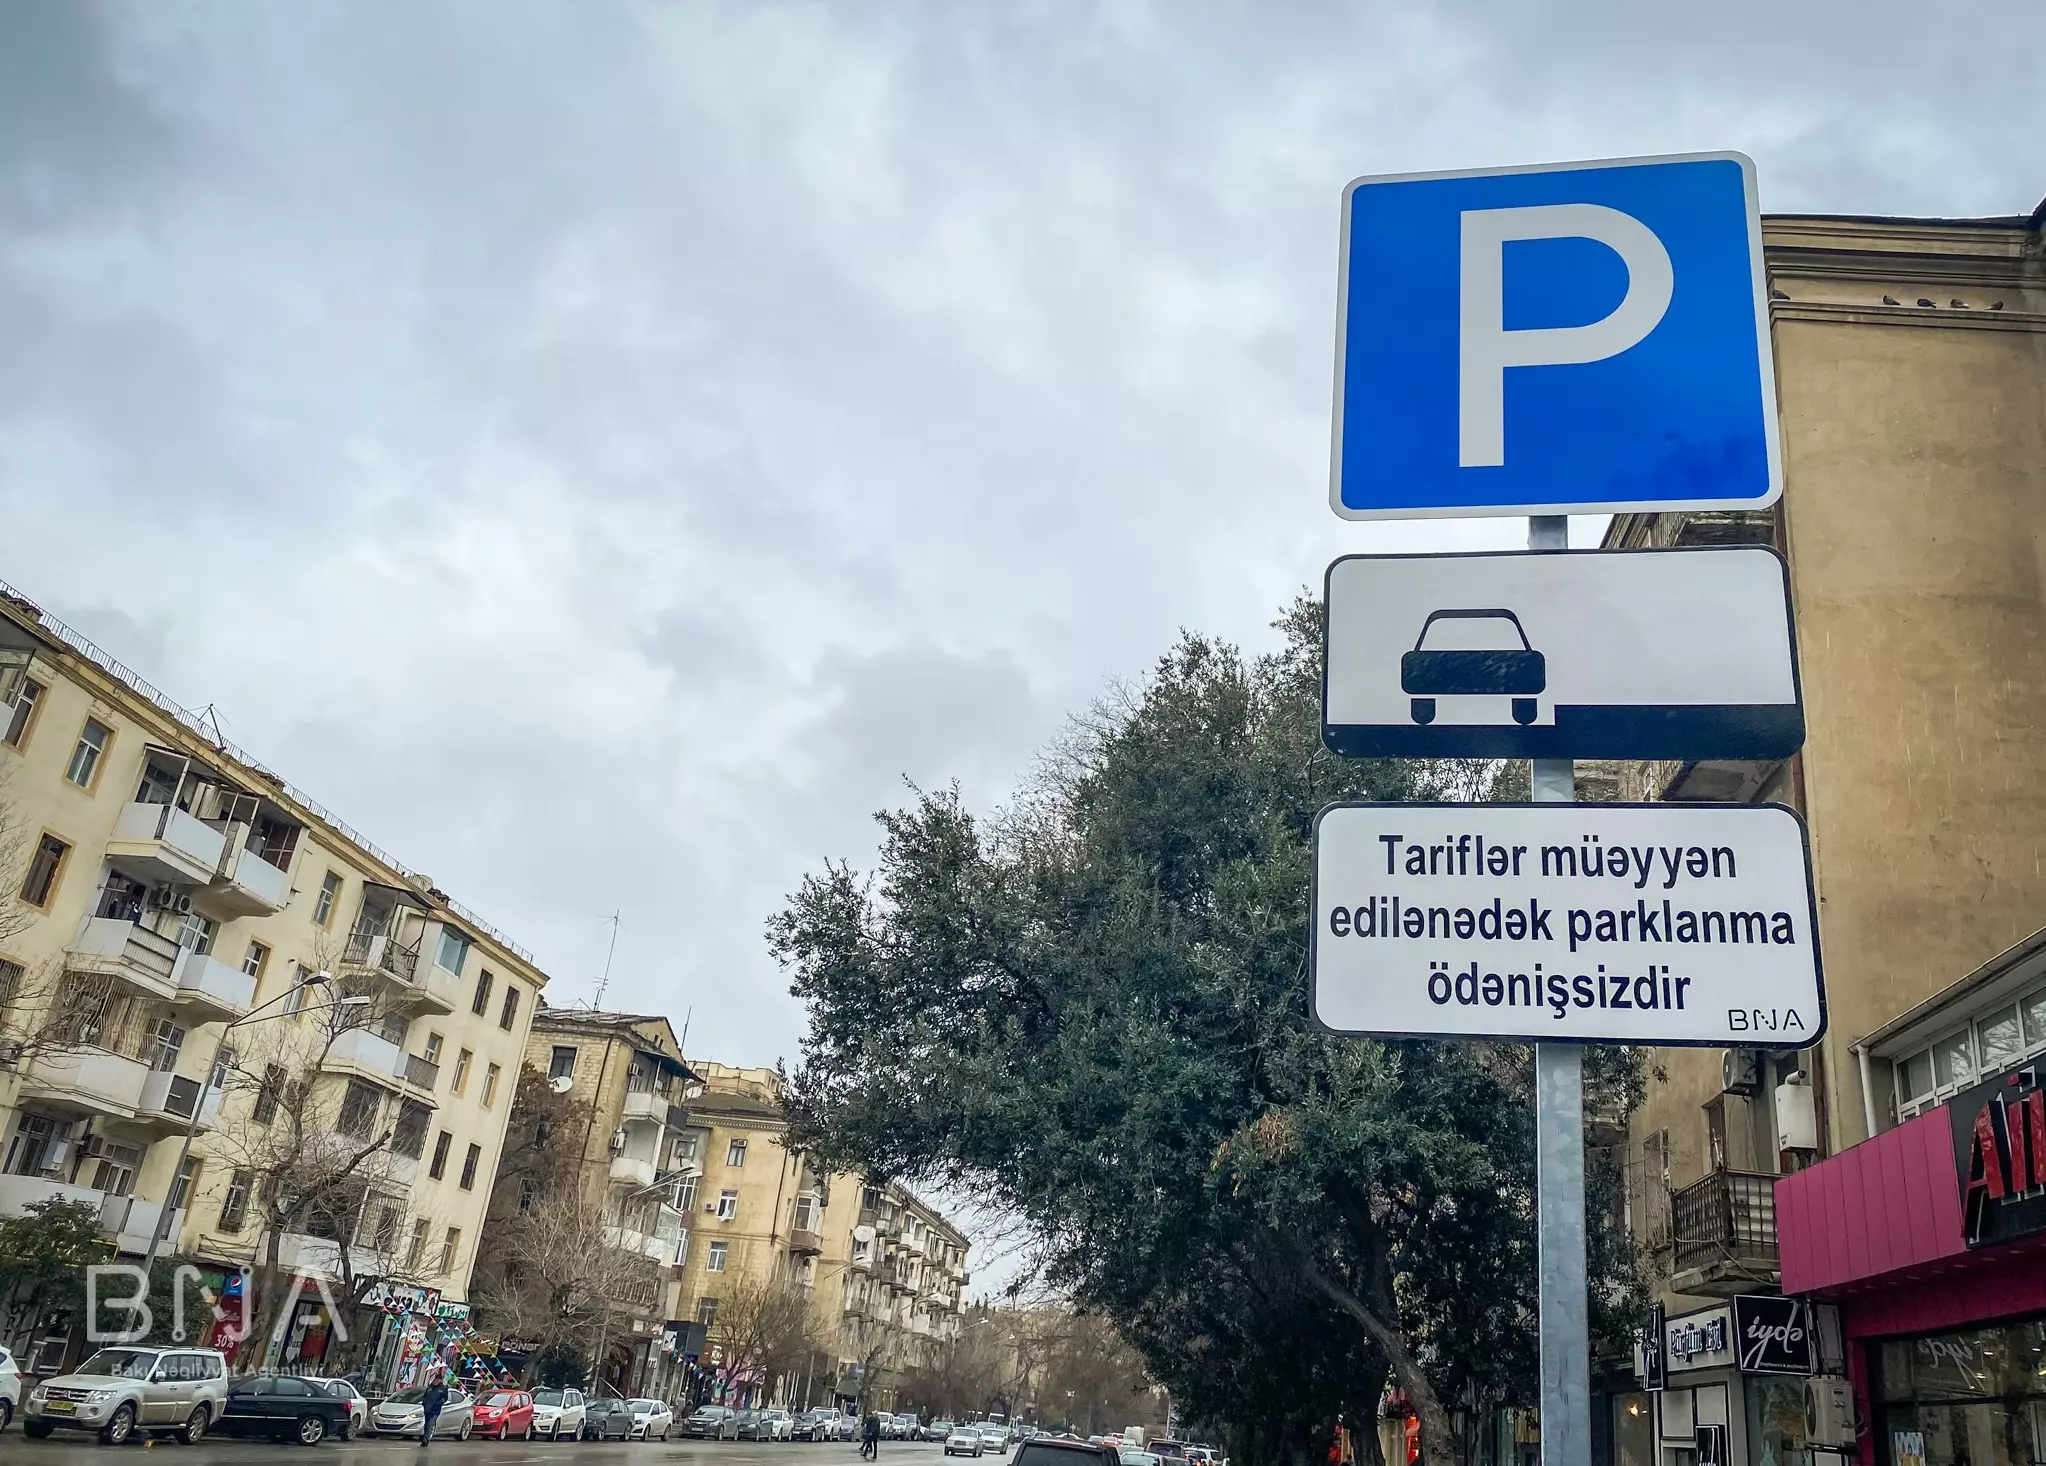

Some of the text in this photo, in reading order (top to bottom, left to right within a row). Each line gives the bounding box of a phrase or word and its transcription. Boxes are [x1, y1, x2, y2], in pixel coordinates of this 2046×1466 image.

[1460, 204, 1673, 467] P
[1379, 835, 1736, 889] Tariflər müəyyən
[1331, 896, 1795, 952] edilənədək parklanma
[1428, 962, 1691, 1019] ödənişsizdir
[1728, 1008, 1805, 1031] BNA
[1743, 1300, 1804, 1369] iydə
